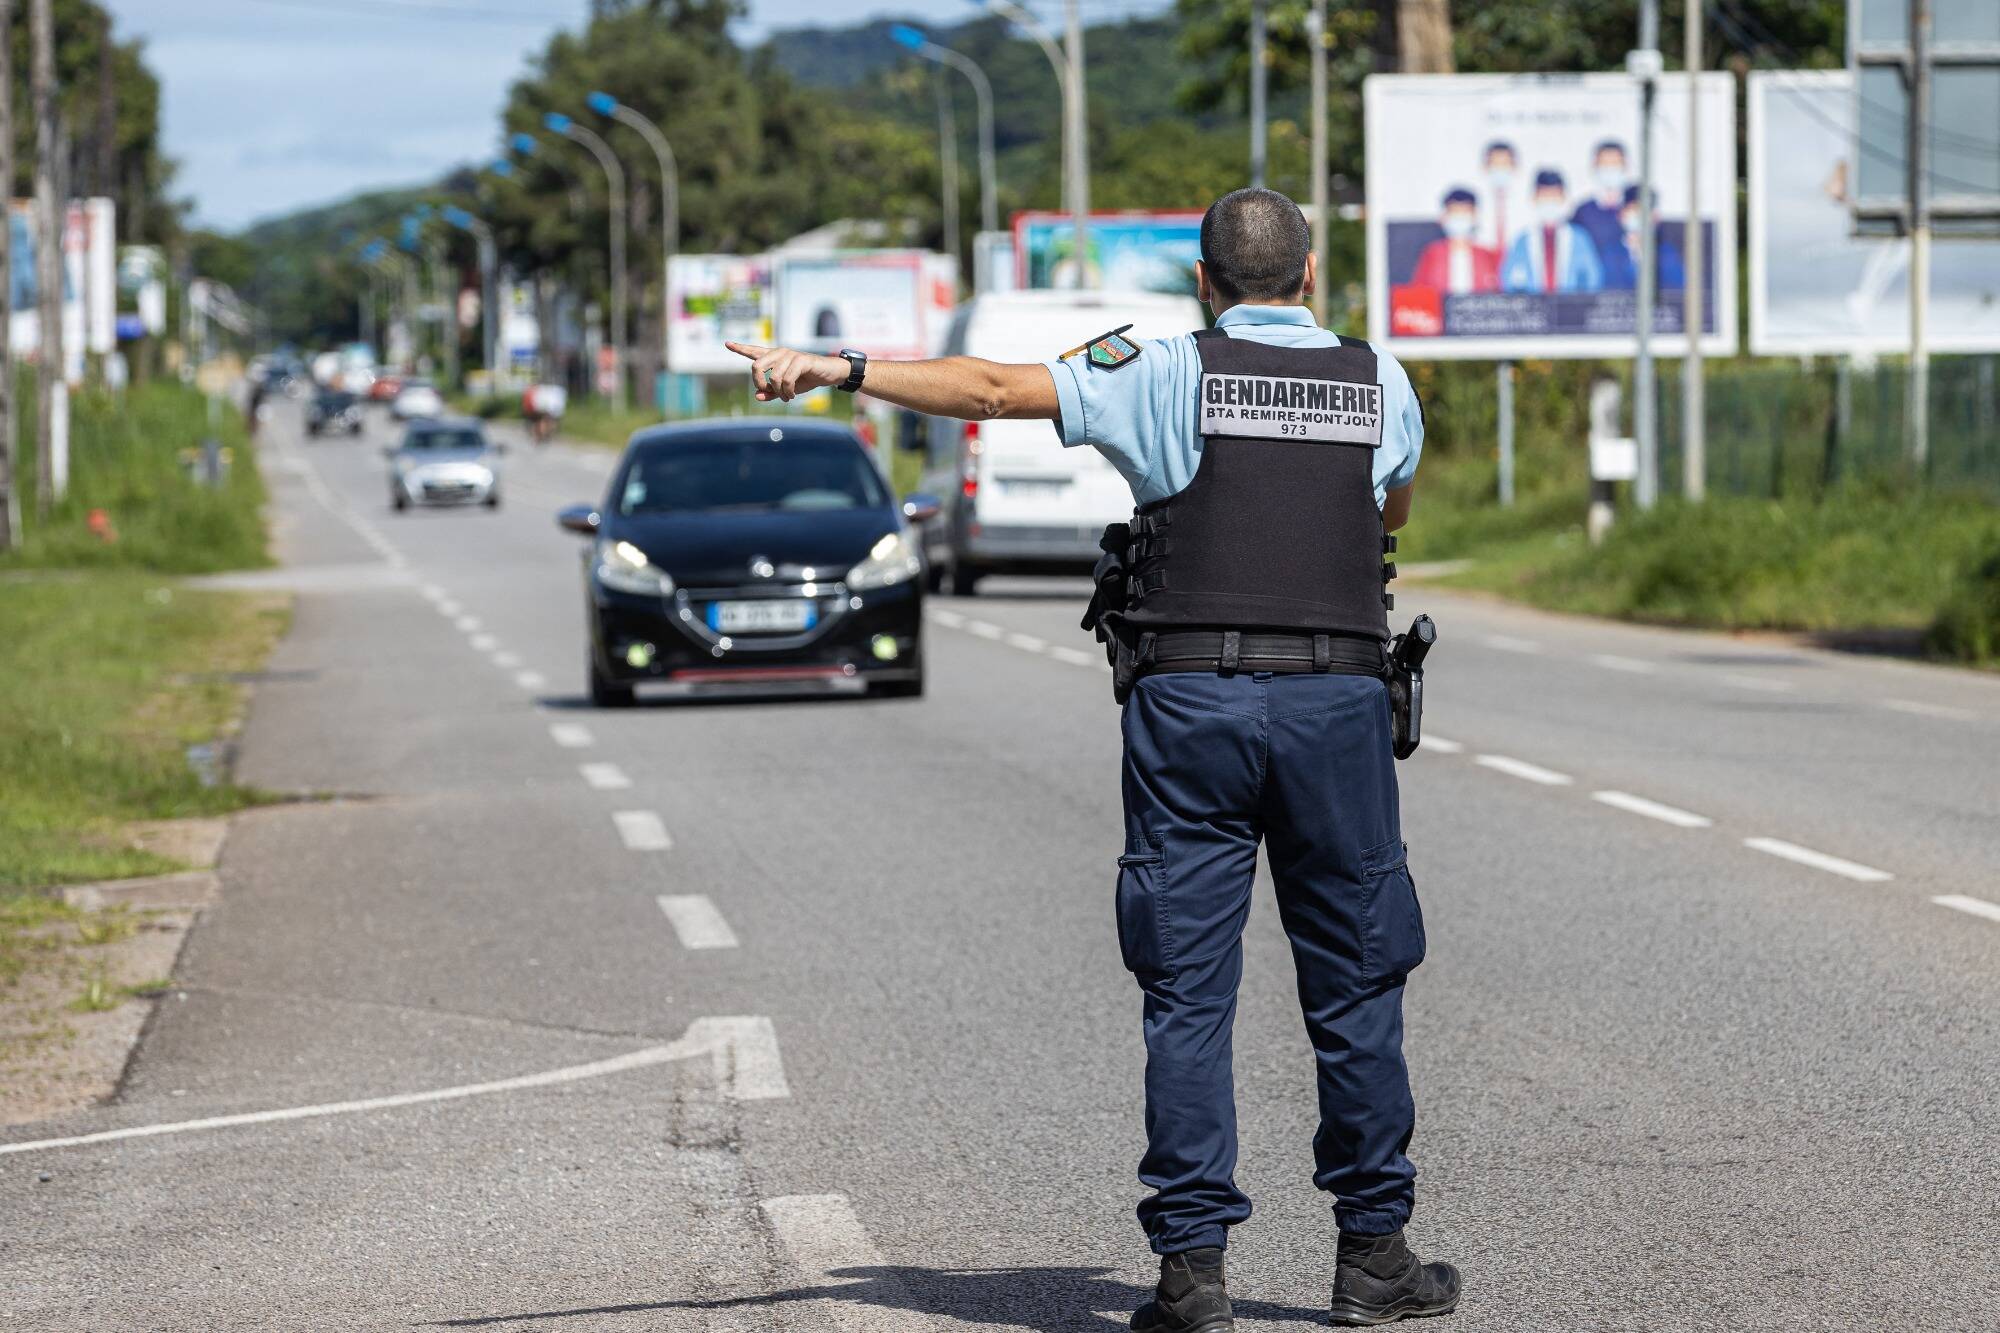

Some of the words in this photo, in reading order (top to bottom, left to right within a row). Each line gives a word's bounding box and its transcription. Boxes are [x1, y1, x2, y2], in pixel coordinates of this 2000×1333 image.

[1206, 378, 1378, 415] GENDARMERIE
[1207, 408, 1235, 419] BTA
[1241, 409, 1377, 428] REMIRE-MONTJOLY
[1281, 424, 1307, 436] 973
